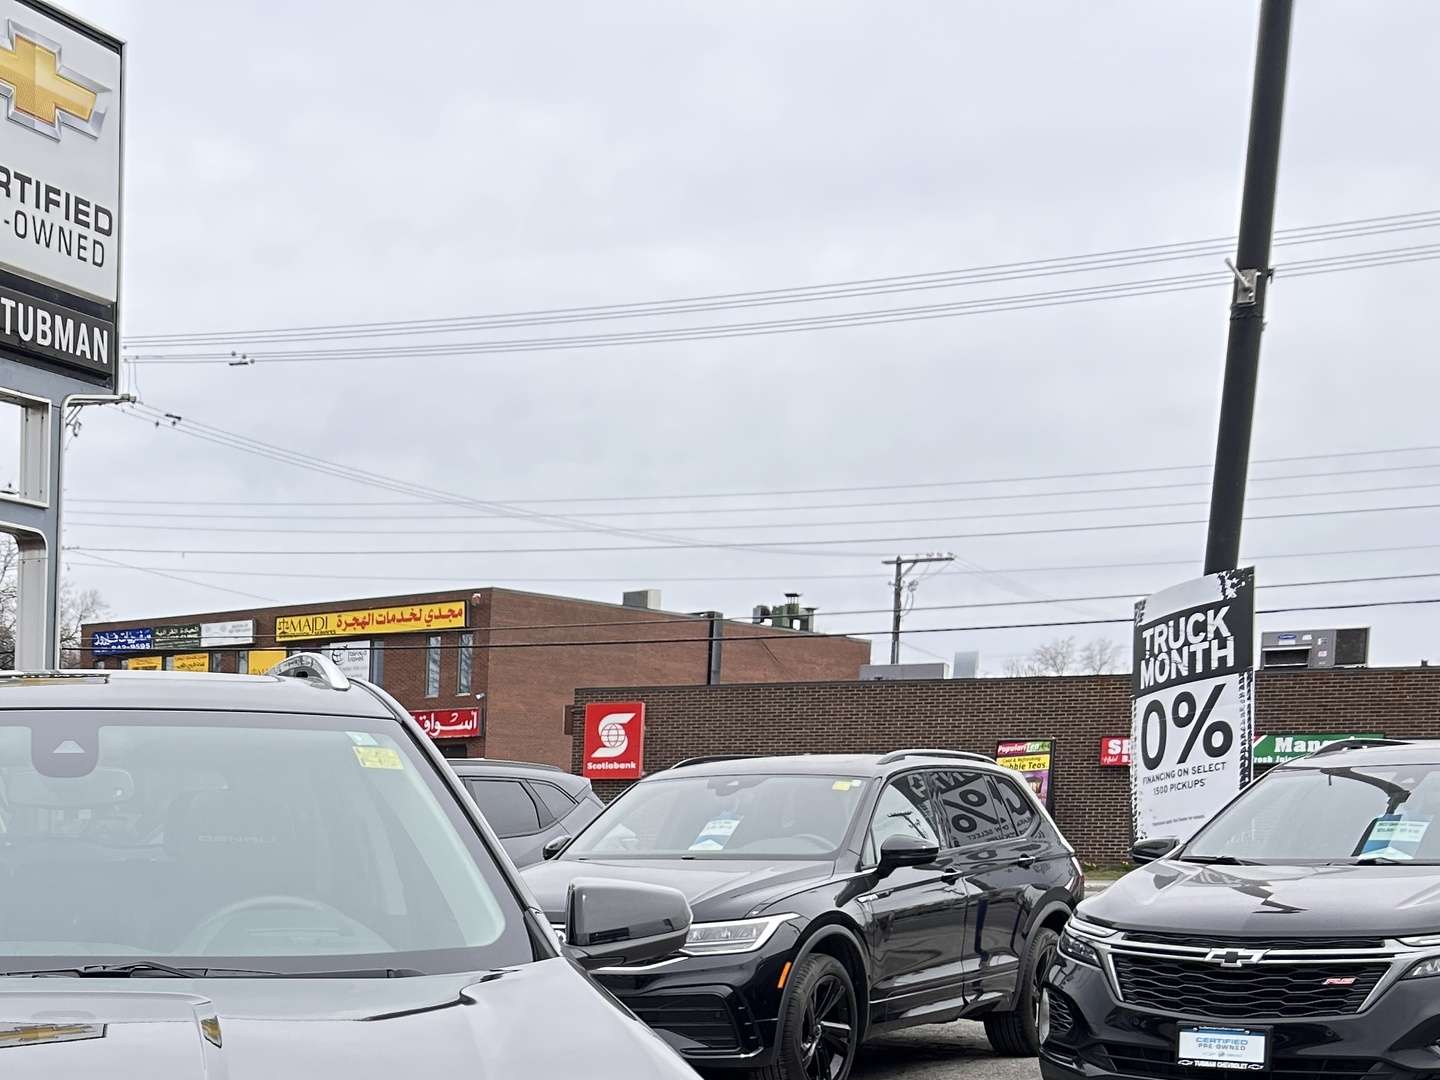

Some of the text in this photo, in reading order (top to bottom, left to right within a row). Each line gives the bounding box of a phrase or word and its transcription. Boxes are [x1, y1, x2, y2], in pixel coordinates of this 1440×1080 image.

[0, 297, 109, 364] TUBMAN
[291, 616, 328, 634] MAJDI
[424, 607, 463, 627] مجدي
[1142, 605, 1231, 659] TRUCK
[1140, 635, 1235, 690] MONTH
[1141, 683, 1233, 771] 0%
[586, 761, 637, 770] Scotiabank
[1143, 761, 1227, 785] FINANCING ON SELECT
[1153, 786, 1169, 796] 1500
